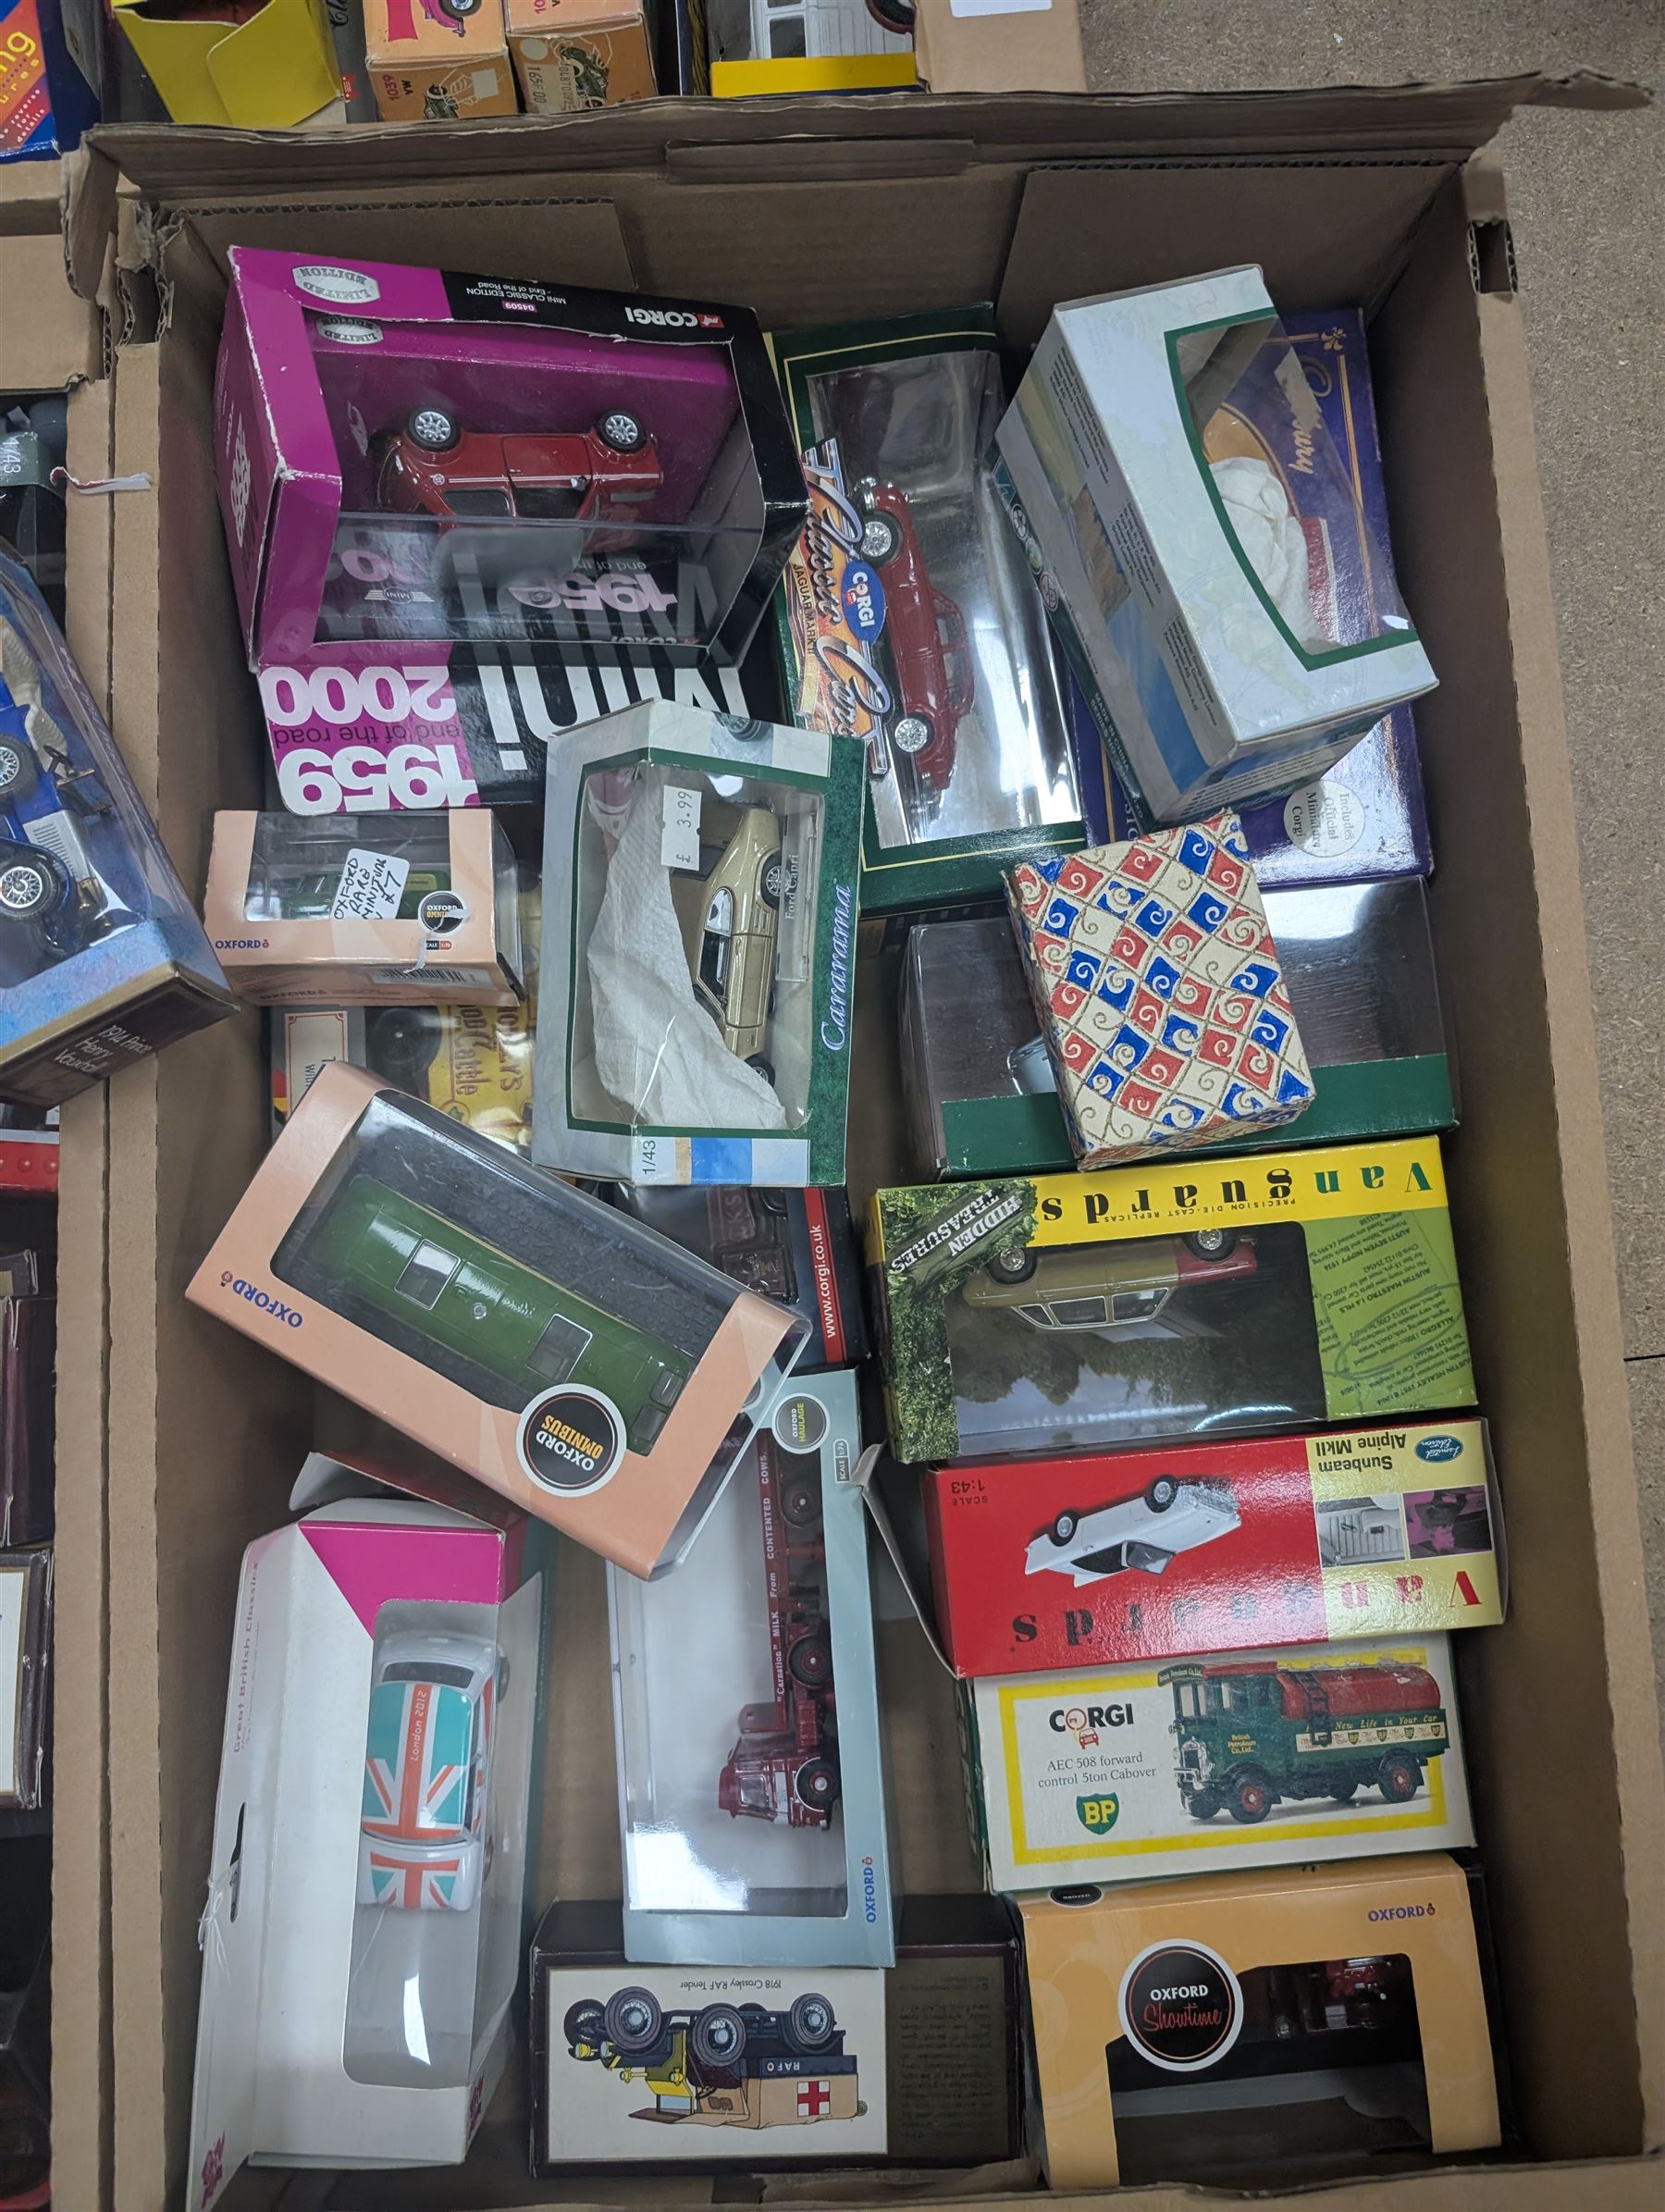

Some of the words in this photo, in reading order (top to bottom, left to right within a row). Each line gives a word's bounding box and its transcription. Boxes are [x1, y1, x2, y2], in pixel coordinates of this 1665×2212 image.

[401, 80, 414, 95] VW
[11, 89, 41, 125] reverse
[17, 114, 31, 129] for
[17, 108, 45, 142] details
[300, 266, 367, 286] EDITION
[477, 281, 501, 290] Road
[502, 283, 517, 291] the
[302, 281, 372, 303] LIMITED
[465, 287, 505, 297] EDITION
[506, 290, 546, 302] CLASSIC
[528, 287, 547, 296] End
[547, 296, 567, 304] MINI
[505, 302, 535, 312] 04509
[624, 306, 699, 327] CORGI
[323, 327, 379, 344] LIMITED
[385, 590, 411, 600] MINI
[793, 563, 813, 611] JAGUAR
[804, 610, 818, 646] MARK
[852, 571, 876, 628] CORGI
[259, 664, 459, 727] 2000
[273, 727, 331, 749] road
[339, 725, 380, 745] the
[385, 724, 408, 745] of
[416, 723, 462, 743] end
[278, 744, 479, 816] 1959
[676, 789, 694, 829] 3.99
[1305, 792, 1321, 848] Miniature
[1324, 797, 1339, 840] Official
[1338, 794, 1355, 842] Includes
[1291, 806, 1304, 837] Corgi
[785, 853, 799, 889] Capri
[333, 857, 360, 921] OXFORD
[784, 890, 796, 921] Ford
[215, 939, 262, 949] OXFORD
[820, 884, 851, 1052] Cararama
[74, 1035, 116, 1063] Henry
[119, 1035, 153, 1055] Prince
[453, 1032, 493, 1096] Cattle
[642, 1138, 657, 1174] 1/43
[1042, 1161, 1434, 1225] Vanguards
[1229, 1196, 1296, 1209] PRECISION
[1102, 1210, 1160, 1222] REPLICAS
[1166, 1204, 1224, 1216] DIE-CAST
[891, 1186, 997, 1275] TREASURES
[949, 1192, 1024, 1256] HIDDEN
[809, 1224, 835, 1339] www.corgi.co.uk
[232, 1279, 303, 1328] OXFORD
[797, 1402, 807, 1443] HAULAGE
[541, 1414, 605, 1460] OMNIBUS
[1314, 1439, 1353, 1455] MkII
[1357, 1432, 1408, 1452] Alpine
[536, 1429, 595, 1472] OXFORD
[838, 1458, 847, 1481] SCALE
[1317, 1454, 1393, 1471] Sunbeam
[950, 1479, 986, 1495] 1:43
[951, 1492, 988, 1506] SCALE
[763, 1496, 775, 1561] CONTENTED
[769, 1571, 778, 1599] From
[771, 1610, 781, 1637] MILK
[414, 1690, 426, 1717] 2012
[1048, 1702, 1135, 1733] CORGI
[1399, 1716, 1418, 1726] Your
[1424, 1714, 1437, 1724] Car
[410, 1721, 423, 1761] London
[1046, 1759, 1074, 1772] AEC
[1076, 1756, 1098, 1769] 508
[1099, 1751, 1144, 1768] forward
[1037, 1773, 1078, 1788] control
[1081, 1770, 1108, 1785] 5ton
[1109, 1766, 1157, 1784] Cabover
[1082, 1799, 1116, 1826] BP
[863, 1866, 877, 1924] OXFORD
[1367, 1905, 1425, 1923] OXFORD
[679, 1979, 707, 1990] Tender
[709, 1979, 727, 1989] RAF
[729, 1977, 762, 1991] Crossley
[763, 1978, 782, 1990] 1918
[1149, 1983, 1210, 2004] OXFORD
[1142, 2000, 1224, 2033] Showtime
[775, 2059, 800, 2071] RAF
